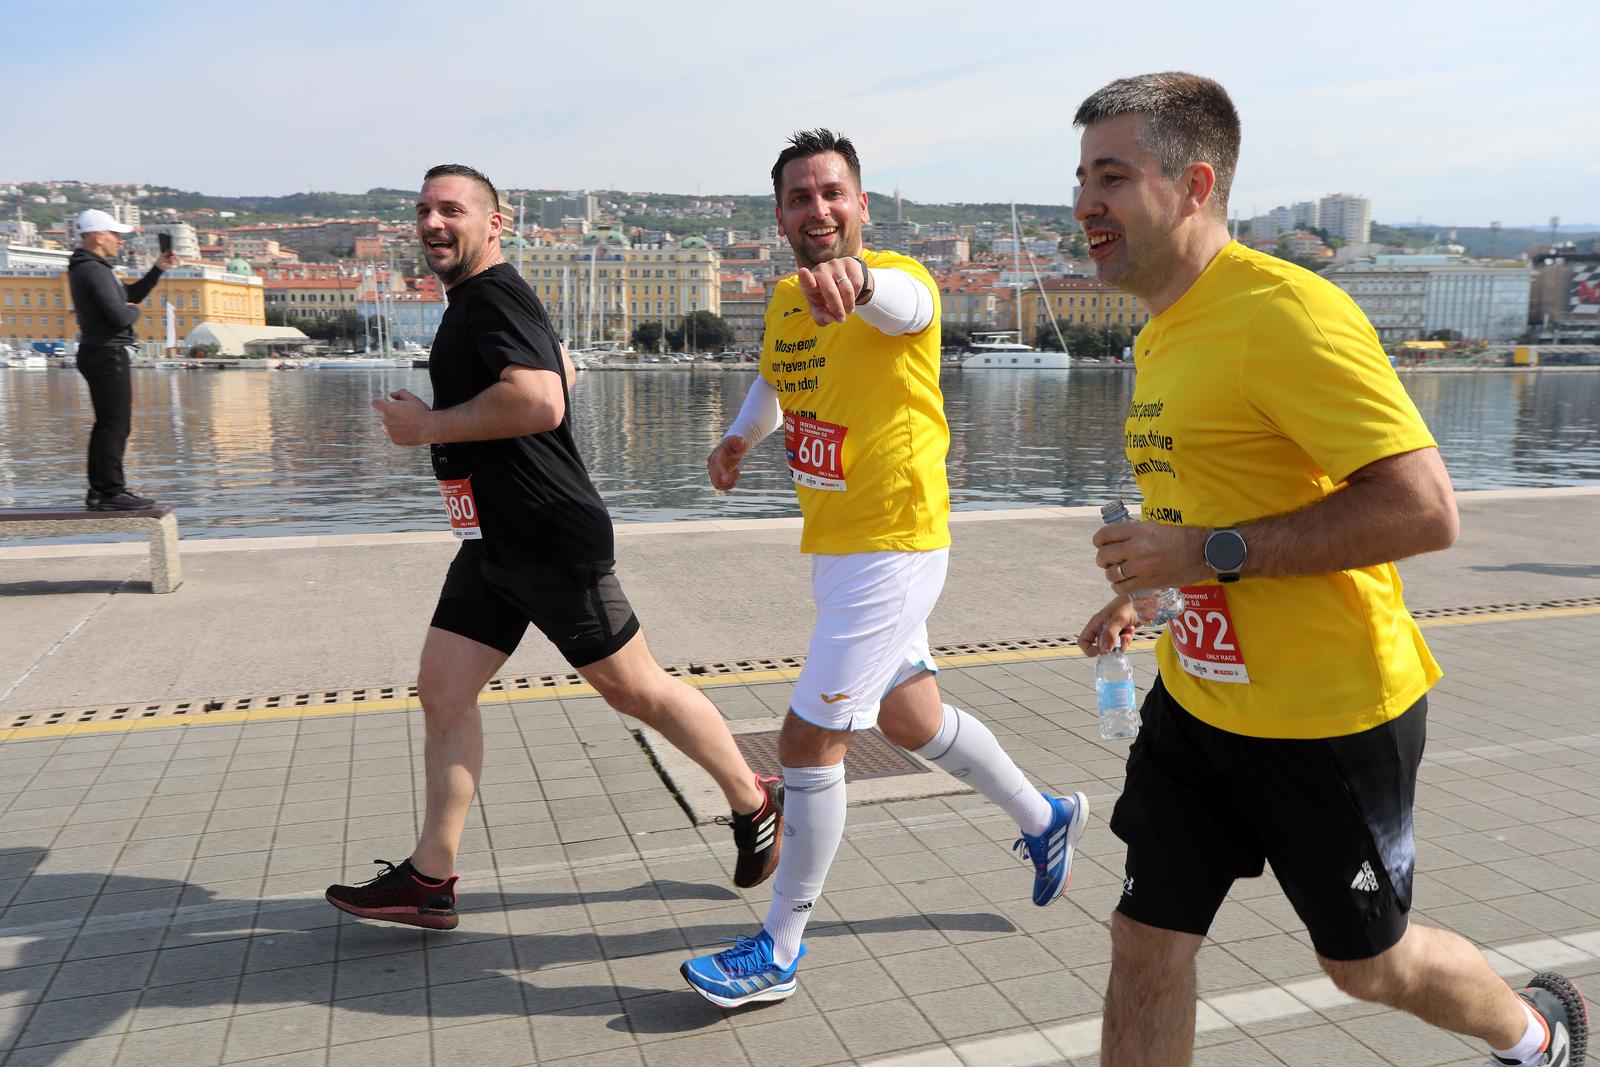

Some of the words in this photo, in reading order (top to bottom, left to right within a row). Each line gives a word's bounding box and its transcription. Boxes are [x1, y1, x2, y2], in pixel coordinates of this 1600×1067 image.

[807, 355, 826, 369] rive
[784, 380, 796, 392] km
[1148, 429, 1173, 451] drive
[798, 436, 836, 471] 601
[1172, 609, 1236, 651] 592
